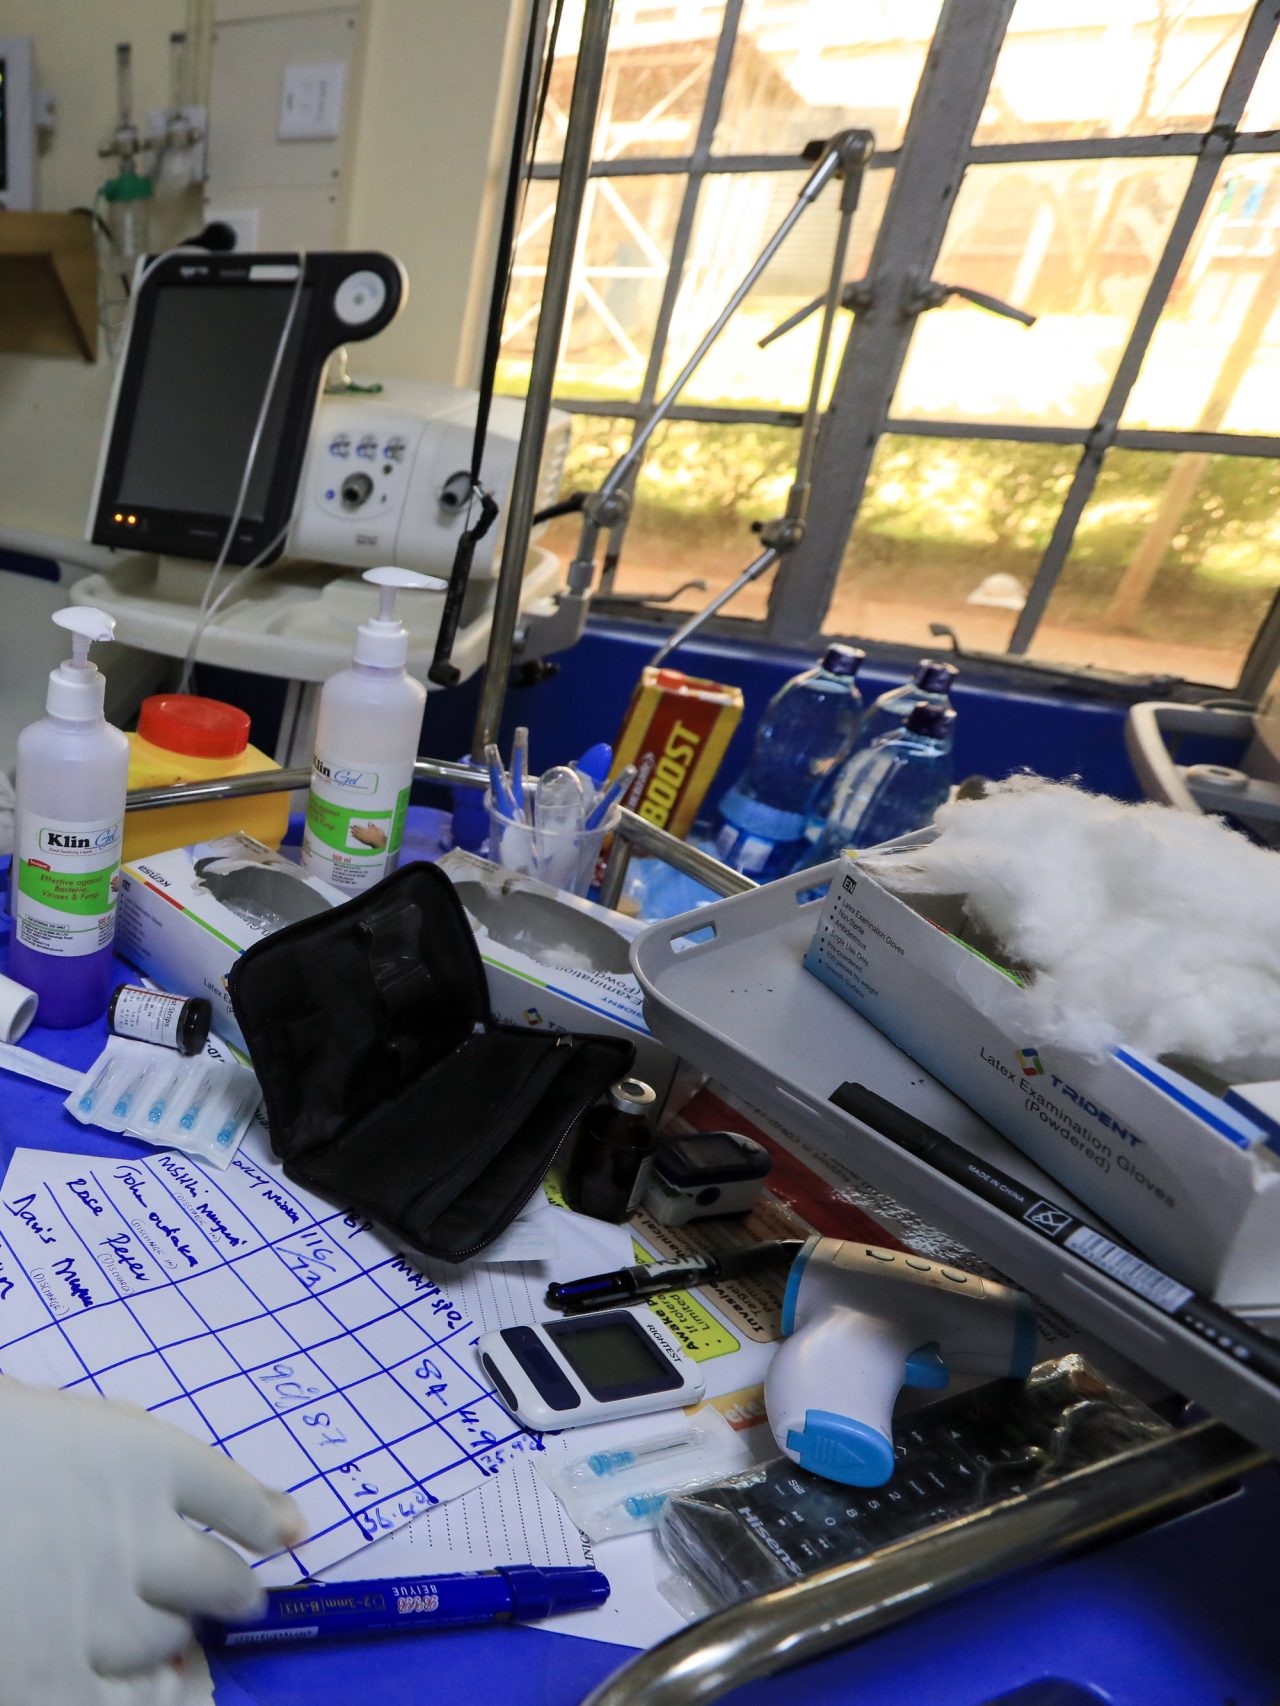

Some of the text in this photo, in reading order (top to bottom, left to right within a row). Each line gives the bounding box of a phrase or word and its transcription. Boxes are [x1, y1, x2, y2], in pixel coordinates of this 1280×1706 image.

[638, 719, 701, 829] BOOST
[48, 833, 90, 848] Klin
[856, 910, 886, 940] Examination
[886, 936, 905, 955] Gloves
[203, 978, 222, 997] Latex
[164, 1004, 176, 1029] Strips
[980, 1047, 1175, 1208] Latex Examination Gloves
[1050, 1074, 1142, 1147] TRIDENT
[1024, 1098, 1112, 1173] (Powdered)
[670, 1293, 711, 1331] Limited
[708, 1281, 765, 1333] Invasive
[646, 1323, 683, 1364] RIGHTEST
[656, 1309, 699, 1350] Awake
[738, 1507, 802, 1577] Hisens
[392, 1584, 439, 1598] BEIYUE
